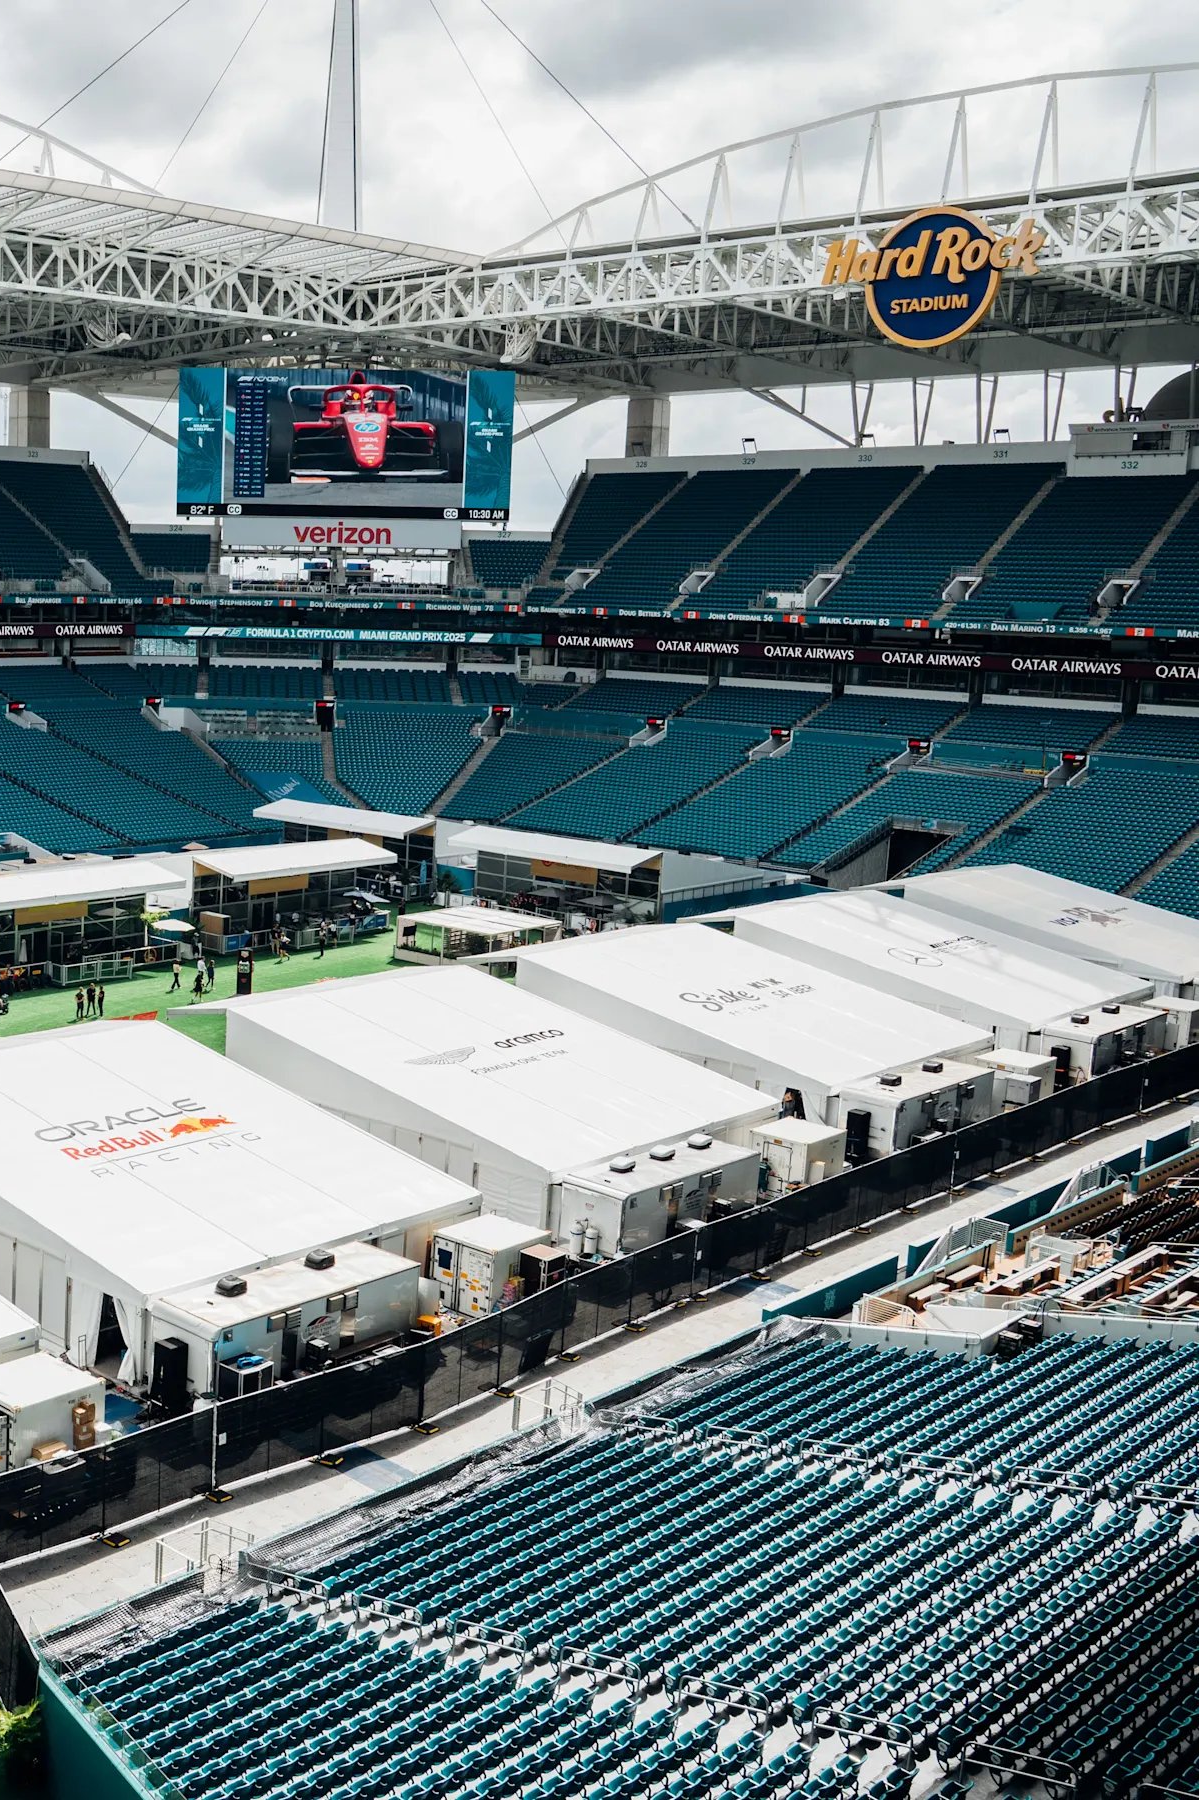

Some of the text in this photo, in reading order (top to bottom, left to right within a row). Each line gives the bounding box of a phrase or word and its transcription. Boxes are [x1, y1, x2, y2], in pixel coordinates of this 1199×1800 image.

[821, 218, 1047, 285] Hard Rock
[889, 293, 969, 315] STADIUM
[27, 450, 38, 458] 323
[857, 454, 873, 462] 330
[993, 450, 1008, 458] 331
[742, 457, 755, 465] 329
[1121, 461, 1139, 469] 332
[207, 506, 214, 515] F
[445, 510, 457, 518] CC
[468, 509, 505, 520] 10:30 AM
[293, 521, 392, 545] verizon
[425, 603, 461, 611] RICHMOND
[662, 610, 671, 618] 75
[708, 612, 773, 622] JOHN OFFERDAHL 56
[819, 616, 890, 626] MARK CLAYTON 83
[991, 622, 1056, 633] DAN MARINO 13
[55, 624, 123, 636] QATAR AIRWAYS
[246, 629, 289, 637] FORMULA
[297, 629, 354, 639] CRYPTO.COM
[359, 631, 389, 640] MIAMI
[389, 631, 421, 641] GRAND
[422, 632, 443, 641] PRIX
[444, 633, 466, 642] 2025
[557, 636, 634, 649] QATAR AIRWAYS
[656, 640, 739, 655] QATAR AIRWAYS
[764, 645, 854, 661] QATAR AIRWAYS
[881, 651, 981, 668] QATAR AIRWAYS
[1011, 657, 1122, 675] QATAR AIRWAYS
[1155, 665, 1199, 680] QATA
[678, 988, 761, 1012] Stake
[493, 1029, 565, 1049] aramco
[470, 1060, 519, 1075] FORMULA
[34, 1098, 206, 1142] ORACLE
[90, 1132, 262, 1178] RACING
